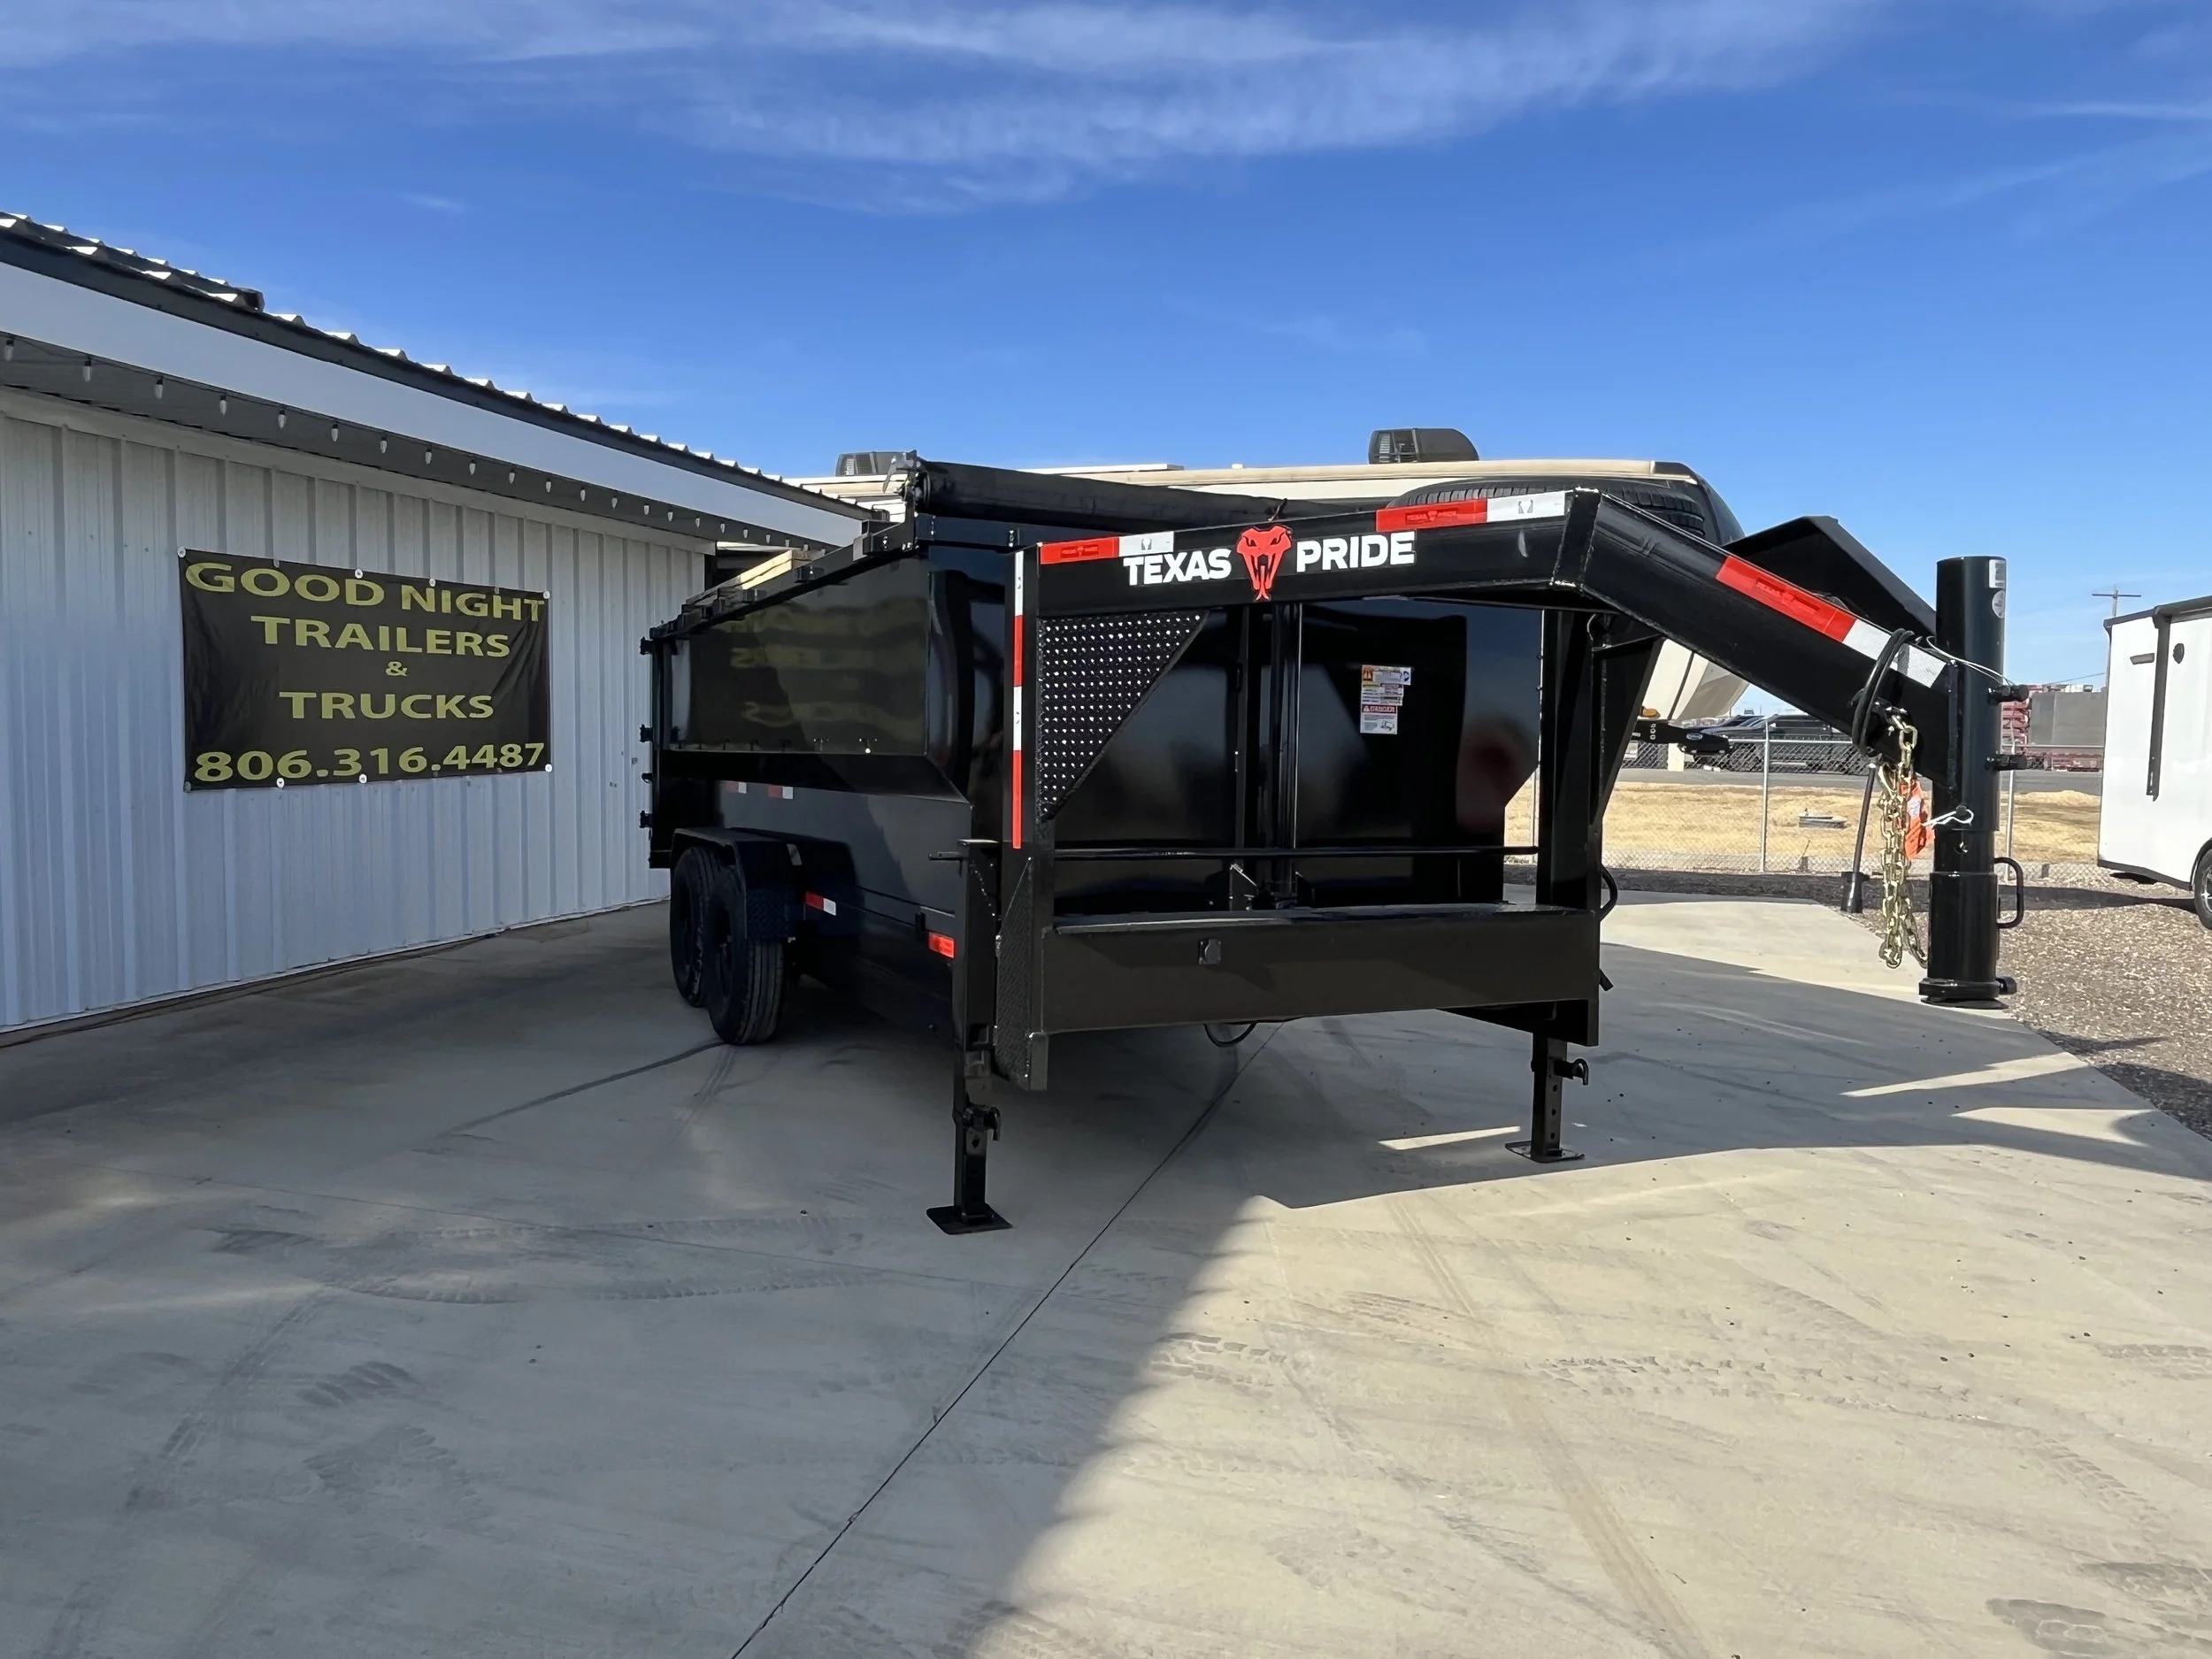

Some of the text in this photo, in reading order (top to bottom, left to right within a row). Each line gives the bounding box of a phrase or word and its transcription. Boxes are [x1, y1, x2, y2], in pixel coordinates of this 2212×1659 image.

[1123, 531, 1416, 586] TEXAS PRIDE
[185, 562, 545, 621] GOOD NIGHT
[250, 615, 511, 657] TRAILERS
[385, 661, 408, 677] &
[279, 691, 494, 719] TRUCKS
[194, 742, 544, 781] 806.316.4487
